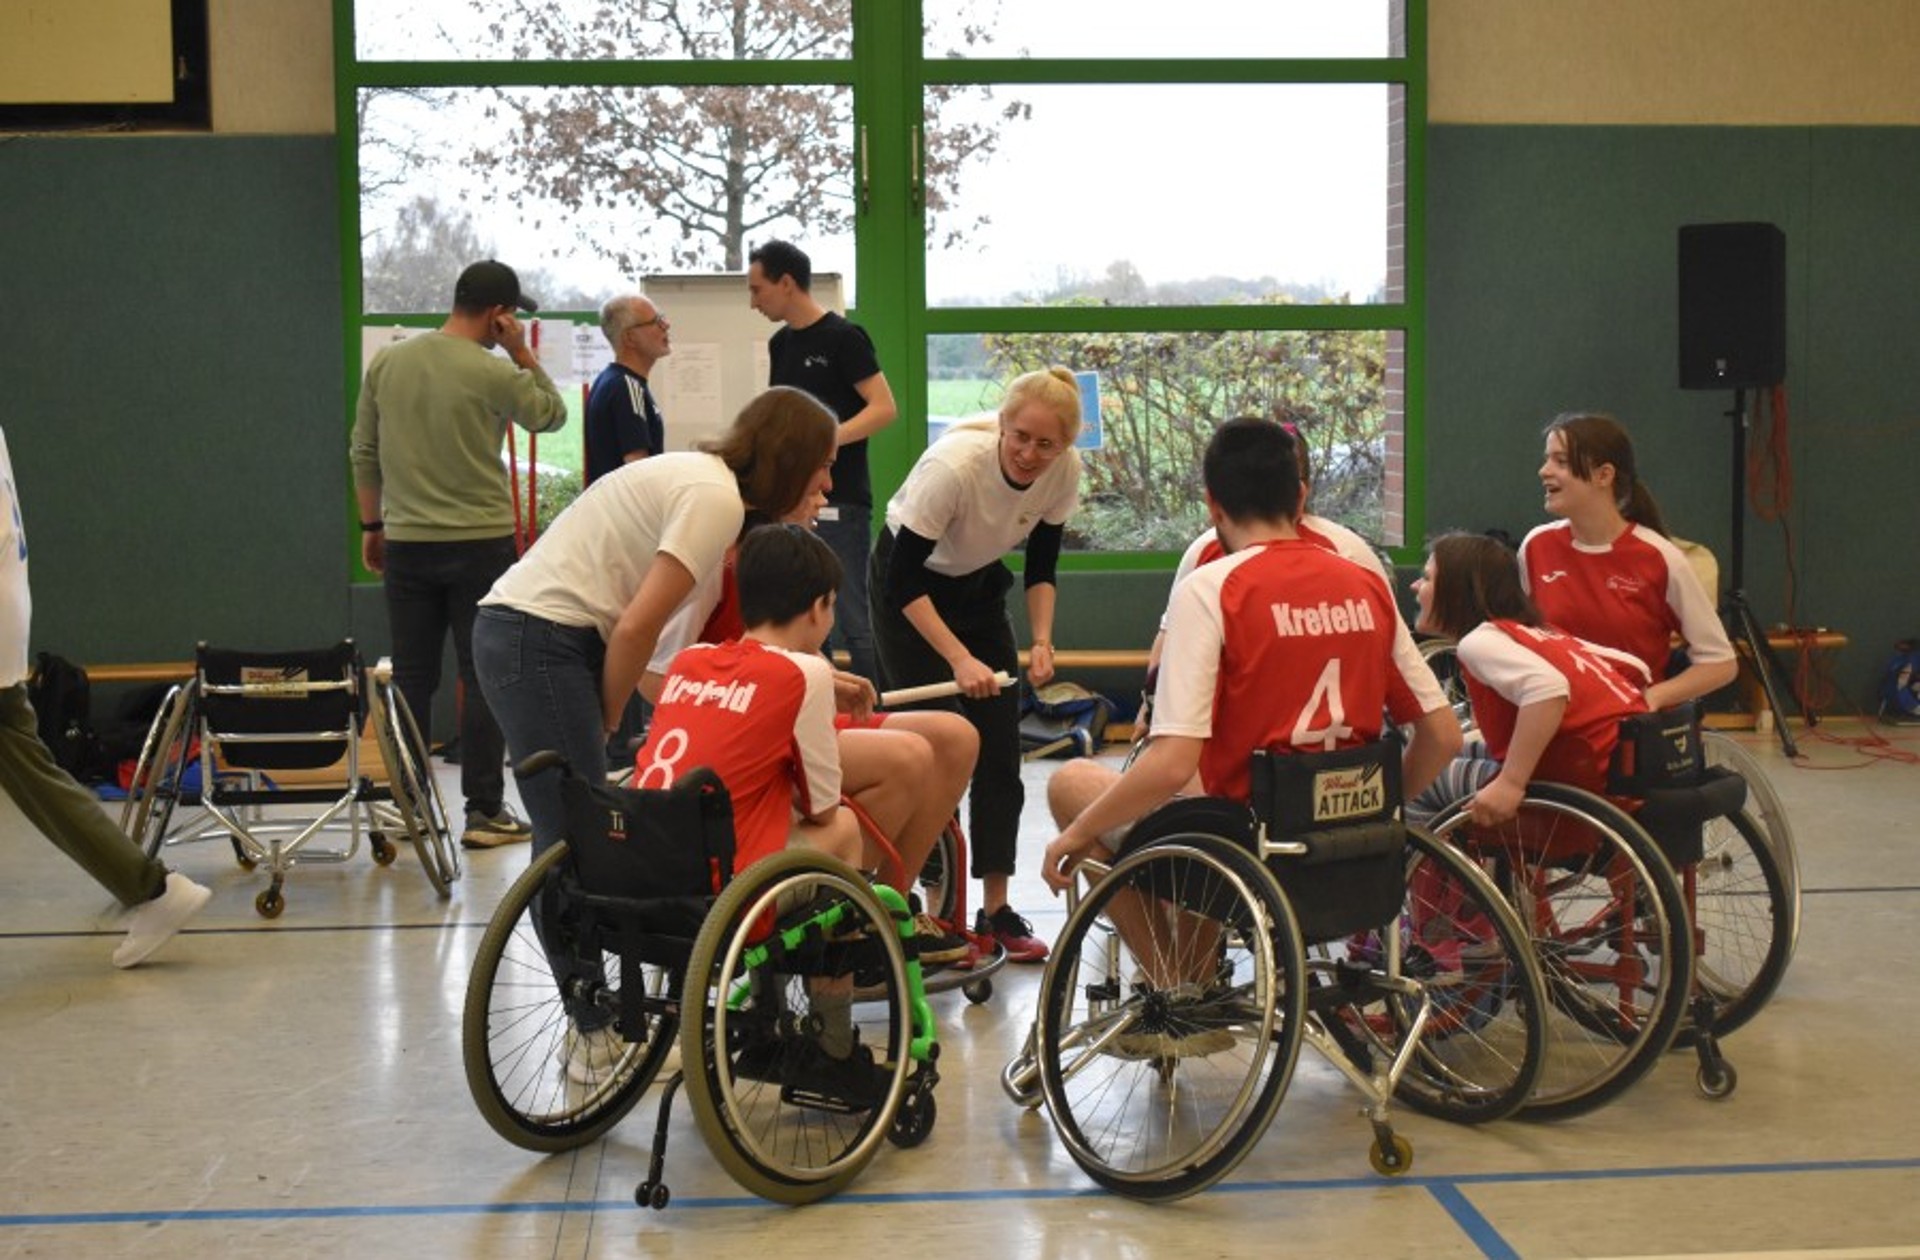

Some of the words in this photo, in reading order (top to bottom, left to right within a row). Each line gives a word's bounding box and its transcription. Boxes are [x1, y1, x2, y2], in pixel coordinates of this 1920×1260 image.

[1270, 598, 1375, 637] Krefeld
[1290, 658, 1353, 751] 4
[638, 728, 689, 790] 8
[1318, 787, 1379, 816] ATTACK
